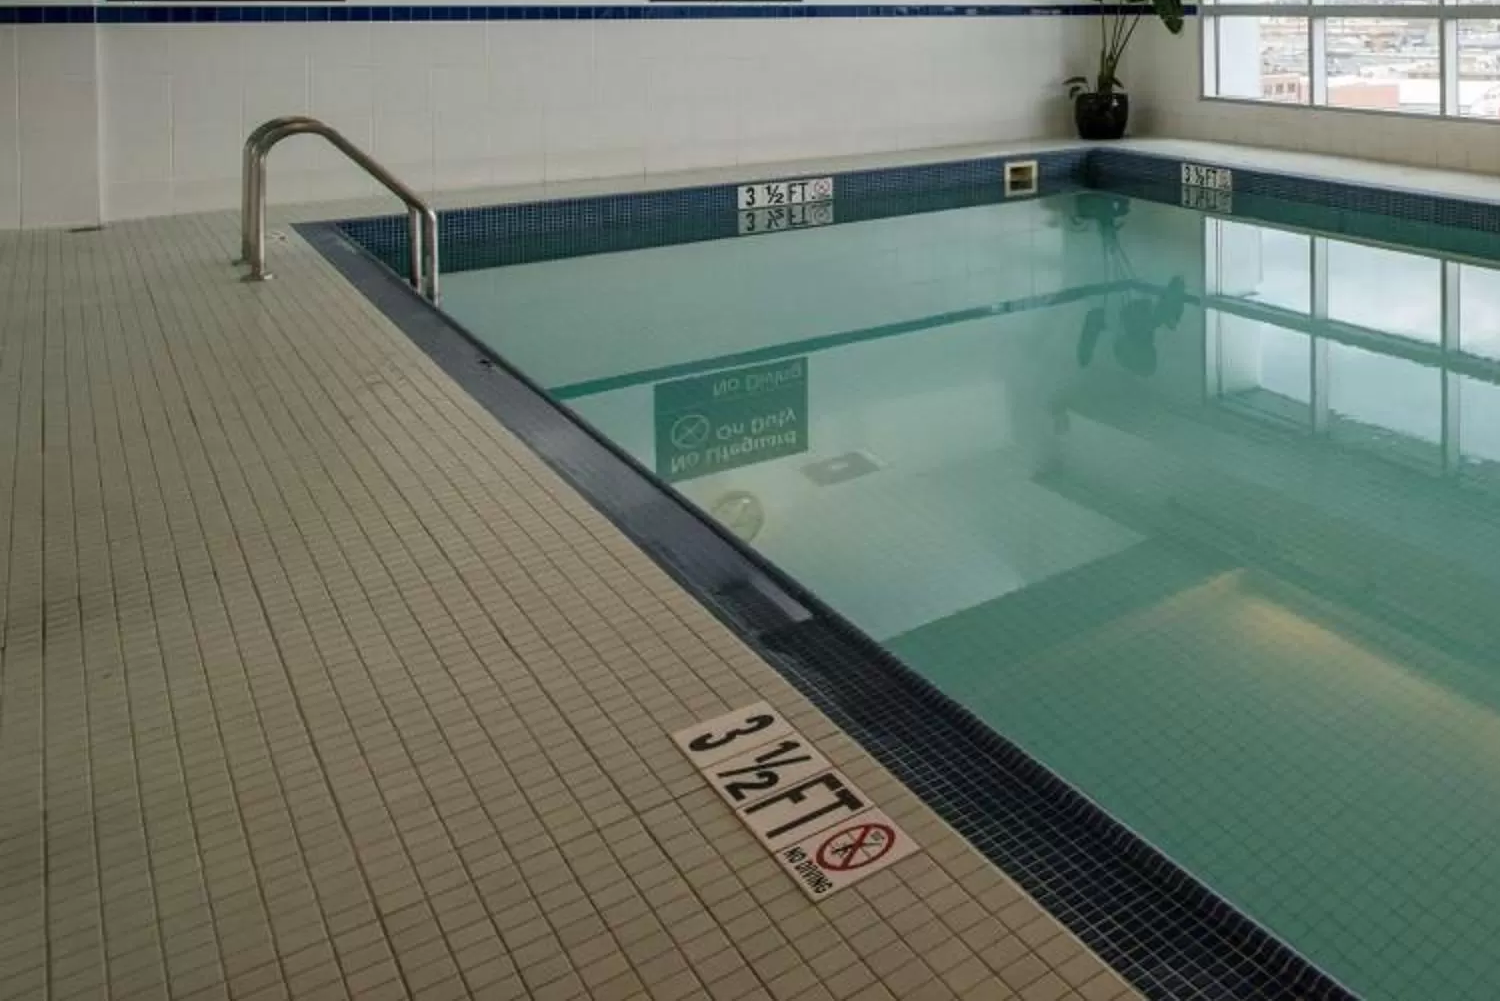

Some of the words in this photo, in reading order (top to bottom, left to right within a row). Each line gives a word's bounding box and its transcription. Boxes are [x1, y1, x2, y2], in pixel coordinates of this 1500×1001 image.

[745, 186, 756, 206] 3
[787, 182, 808, 203] FT
[688, 714, 774, 751] 3
[746, 772, 865, 839] FT
[783, 846, 806, 863] NO
[794, 860, 833, 893] DIVING
